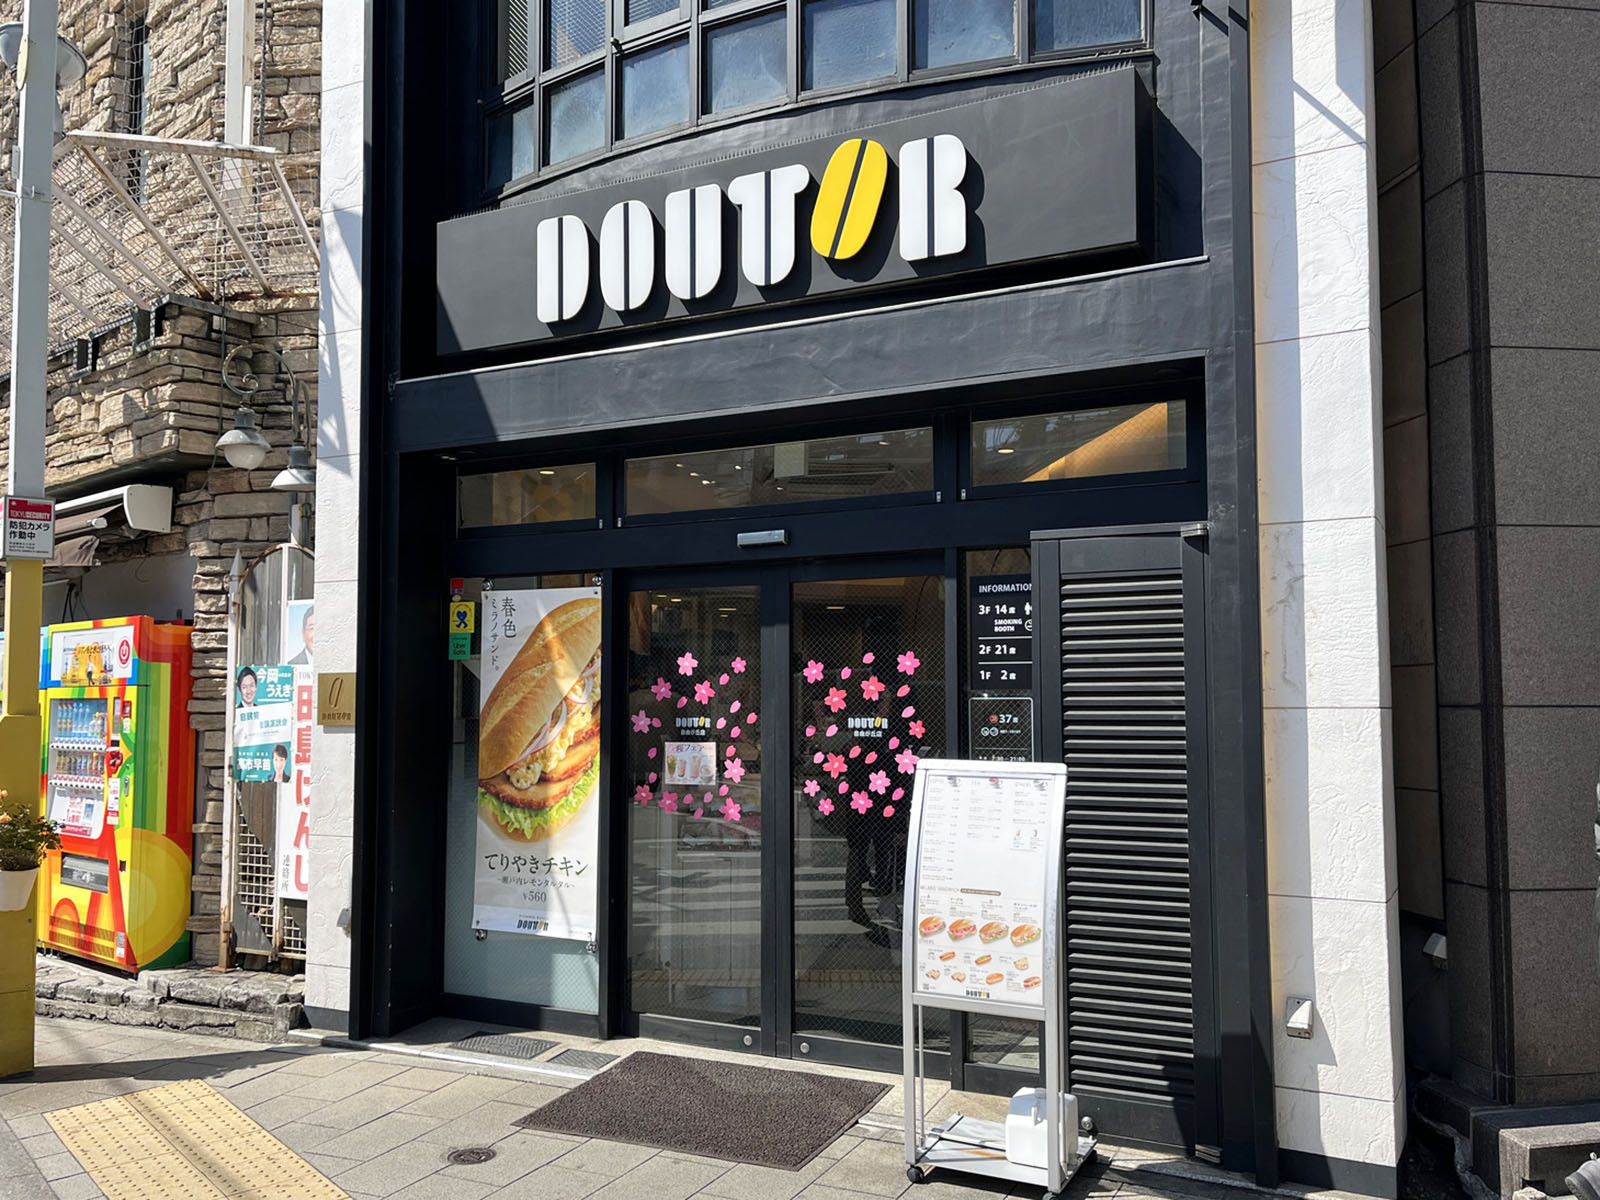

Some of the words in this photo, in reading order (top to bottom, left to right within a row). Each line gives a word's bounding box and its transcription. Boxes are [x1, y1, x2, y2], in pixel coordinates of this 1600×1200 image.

[537, 134, 966, 323] DOUTOR
[9, 521, 50, 531] 防犯カメラ
[9, 531, 36, 540] 作動中
[978, 605, 991, 615] 3F
[501, 596, 517, 638] 春色
[978, 645, 991, 655] 2F
[979, 670, 991, 680] 1F
[266, 684, 291, 697] うえき
[675, 716, 711, 728] DOUTOR
[848, 716, 888, 729] DOUTOR
[484, 853, 589, 877] てりやきチキン
[517, 919, 549, 931] DOUTOR
